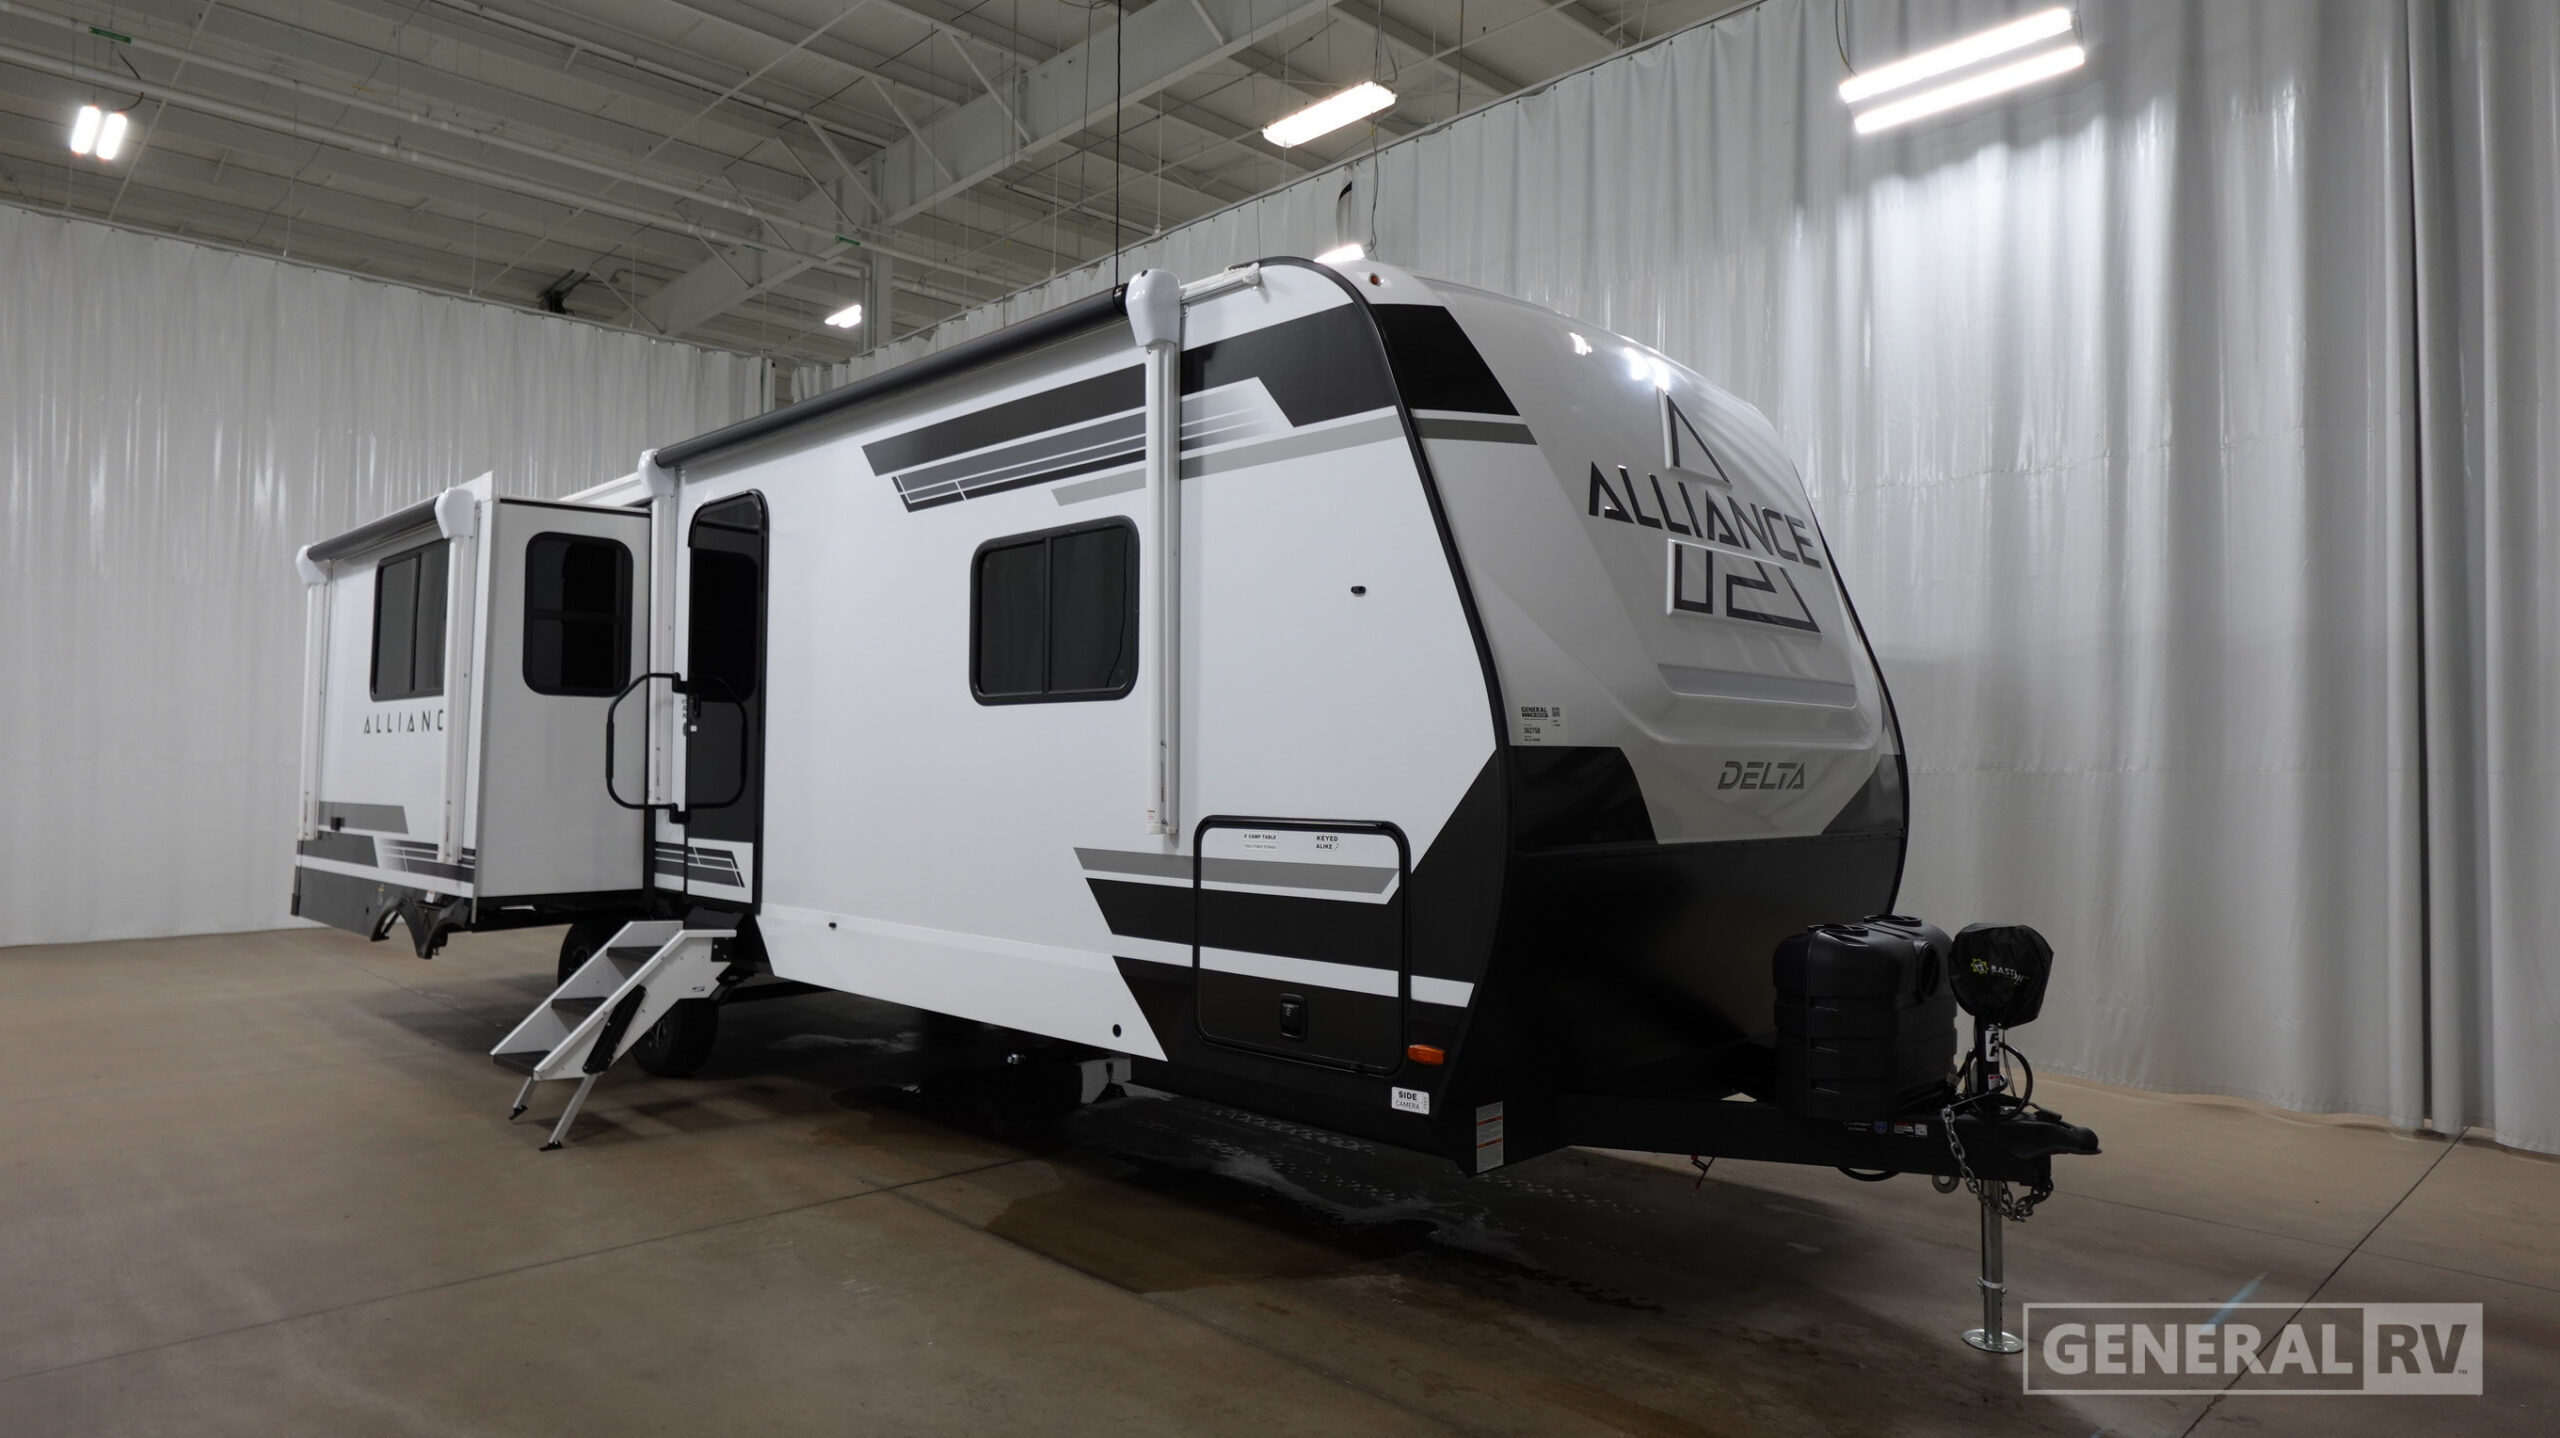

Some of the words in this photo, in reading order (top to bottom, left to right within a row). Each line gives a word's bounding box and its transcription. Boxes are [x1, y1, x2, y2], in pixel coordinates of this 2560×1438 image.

[1589, 460, 1822, 568] ALLIANCE
[363, 708, 444, 734] ALLIANC
[1717, 760, 1805, 790] DELTA
[1395, 1100, 1420, 1110] CAMERA
[1398, 1091, 1418, 1101] SIDE
